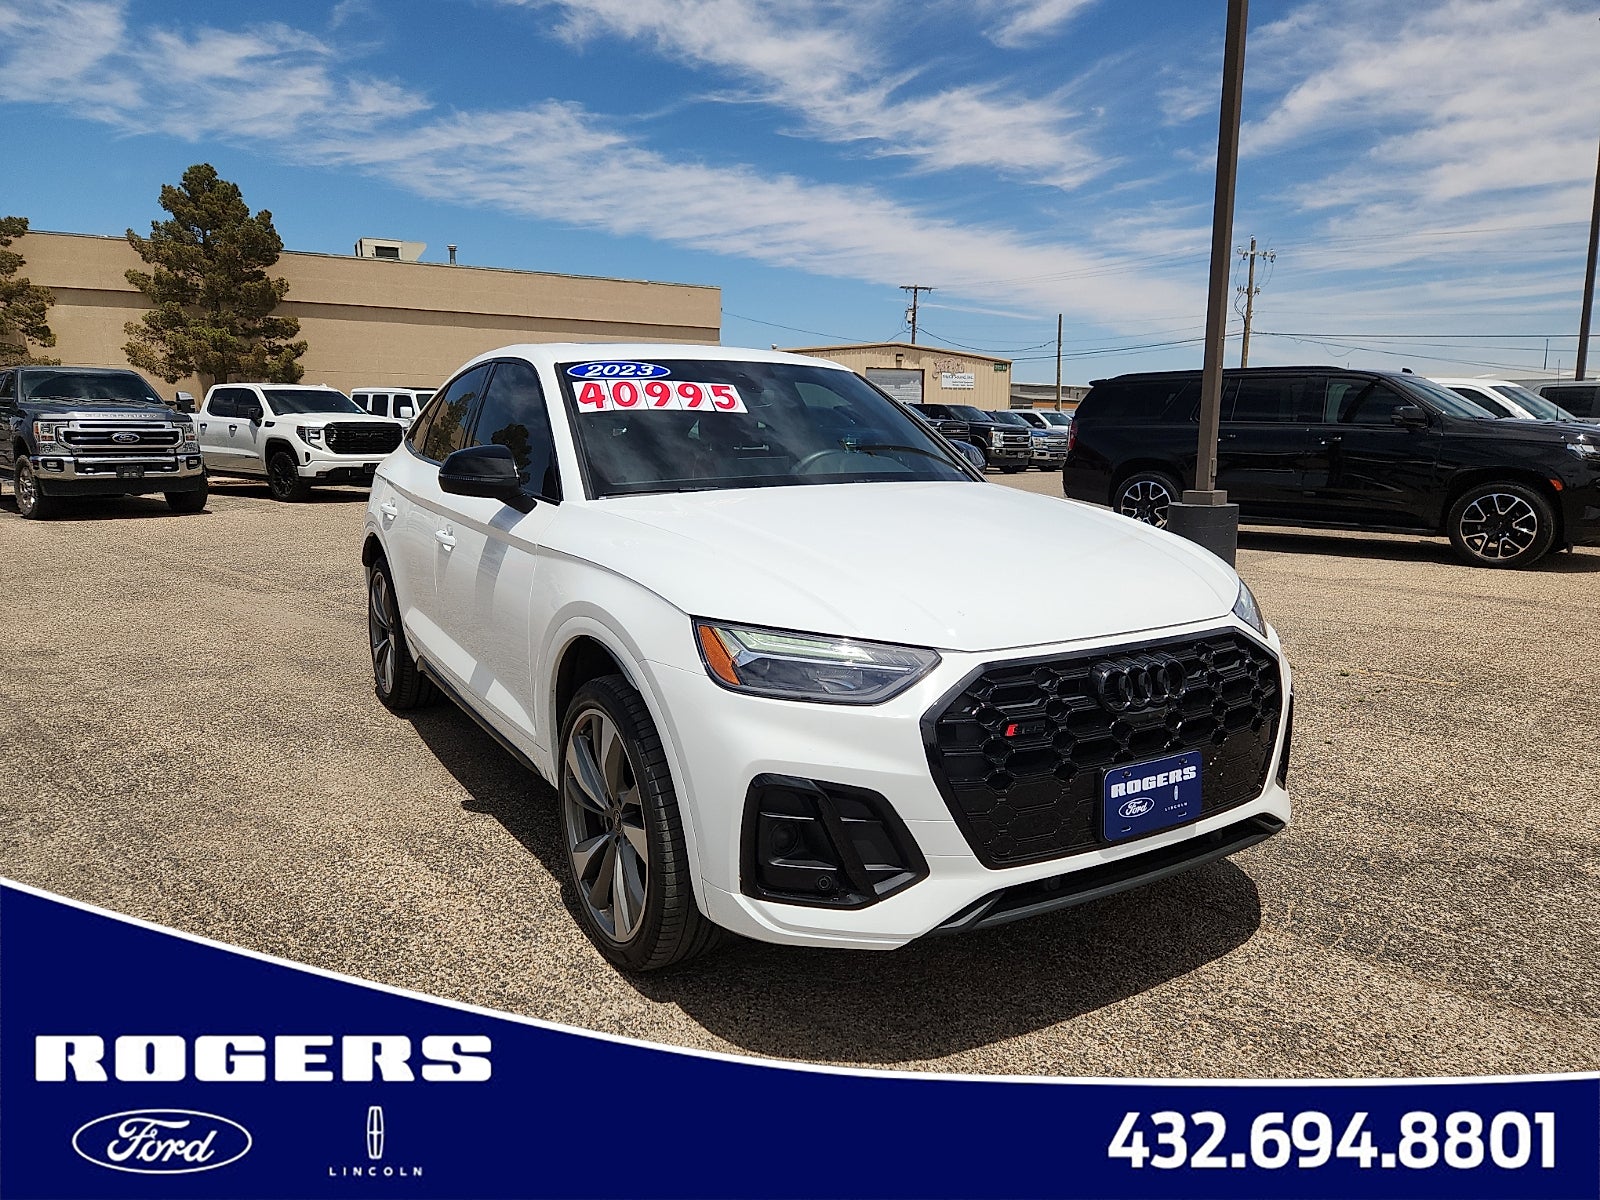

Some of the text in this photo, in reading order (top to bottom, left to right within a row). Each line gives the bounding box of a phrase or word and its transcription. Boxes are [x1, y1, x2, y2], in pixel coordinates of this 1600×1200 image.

[585, 364, 654, 377] 2023
[578, 381, 737, 410] 40995
[1110, 766, 1197, 799] ROGERS
[1125, 800, 1148, 816] Ford
[1164, 802, 1188, 812] LINCOLN
